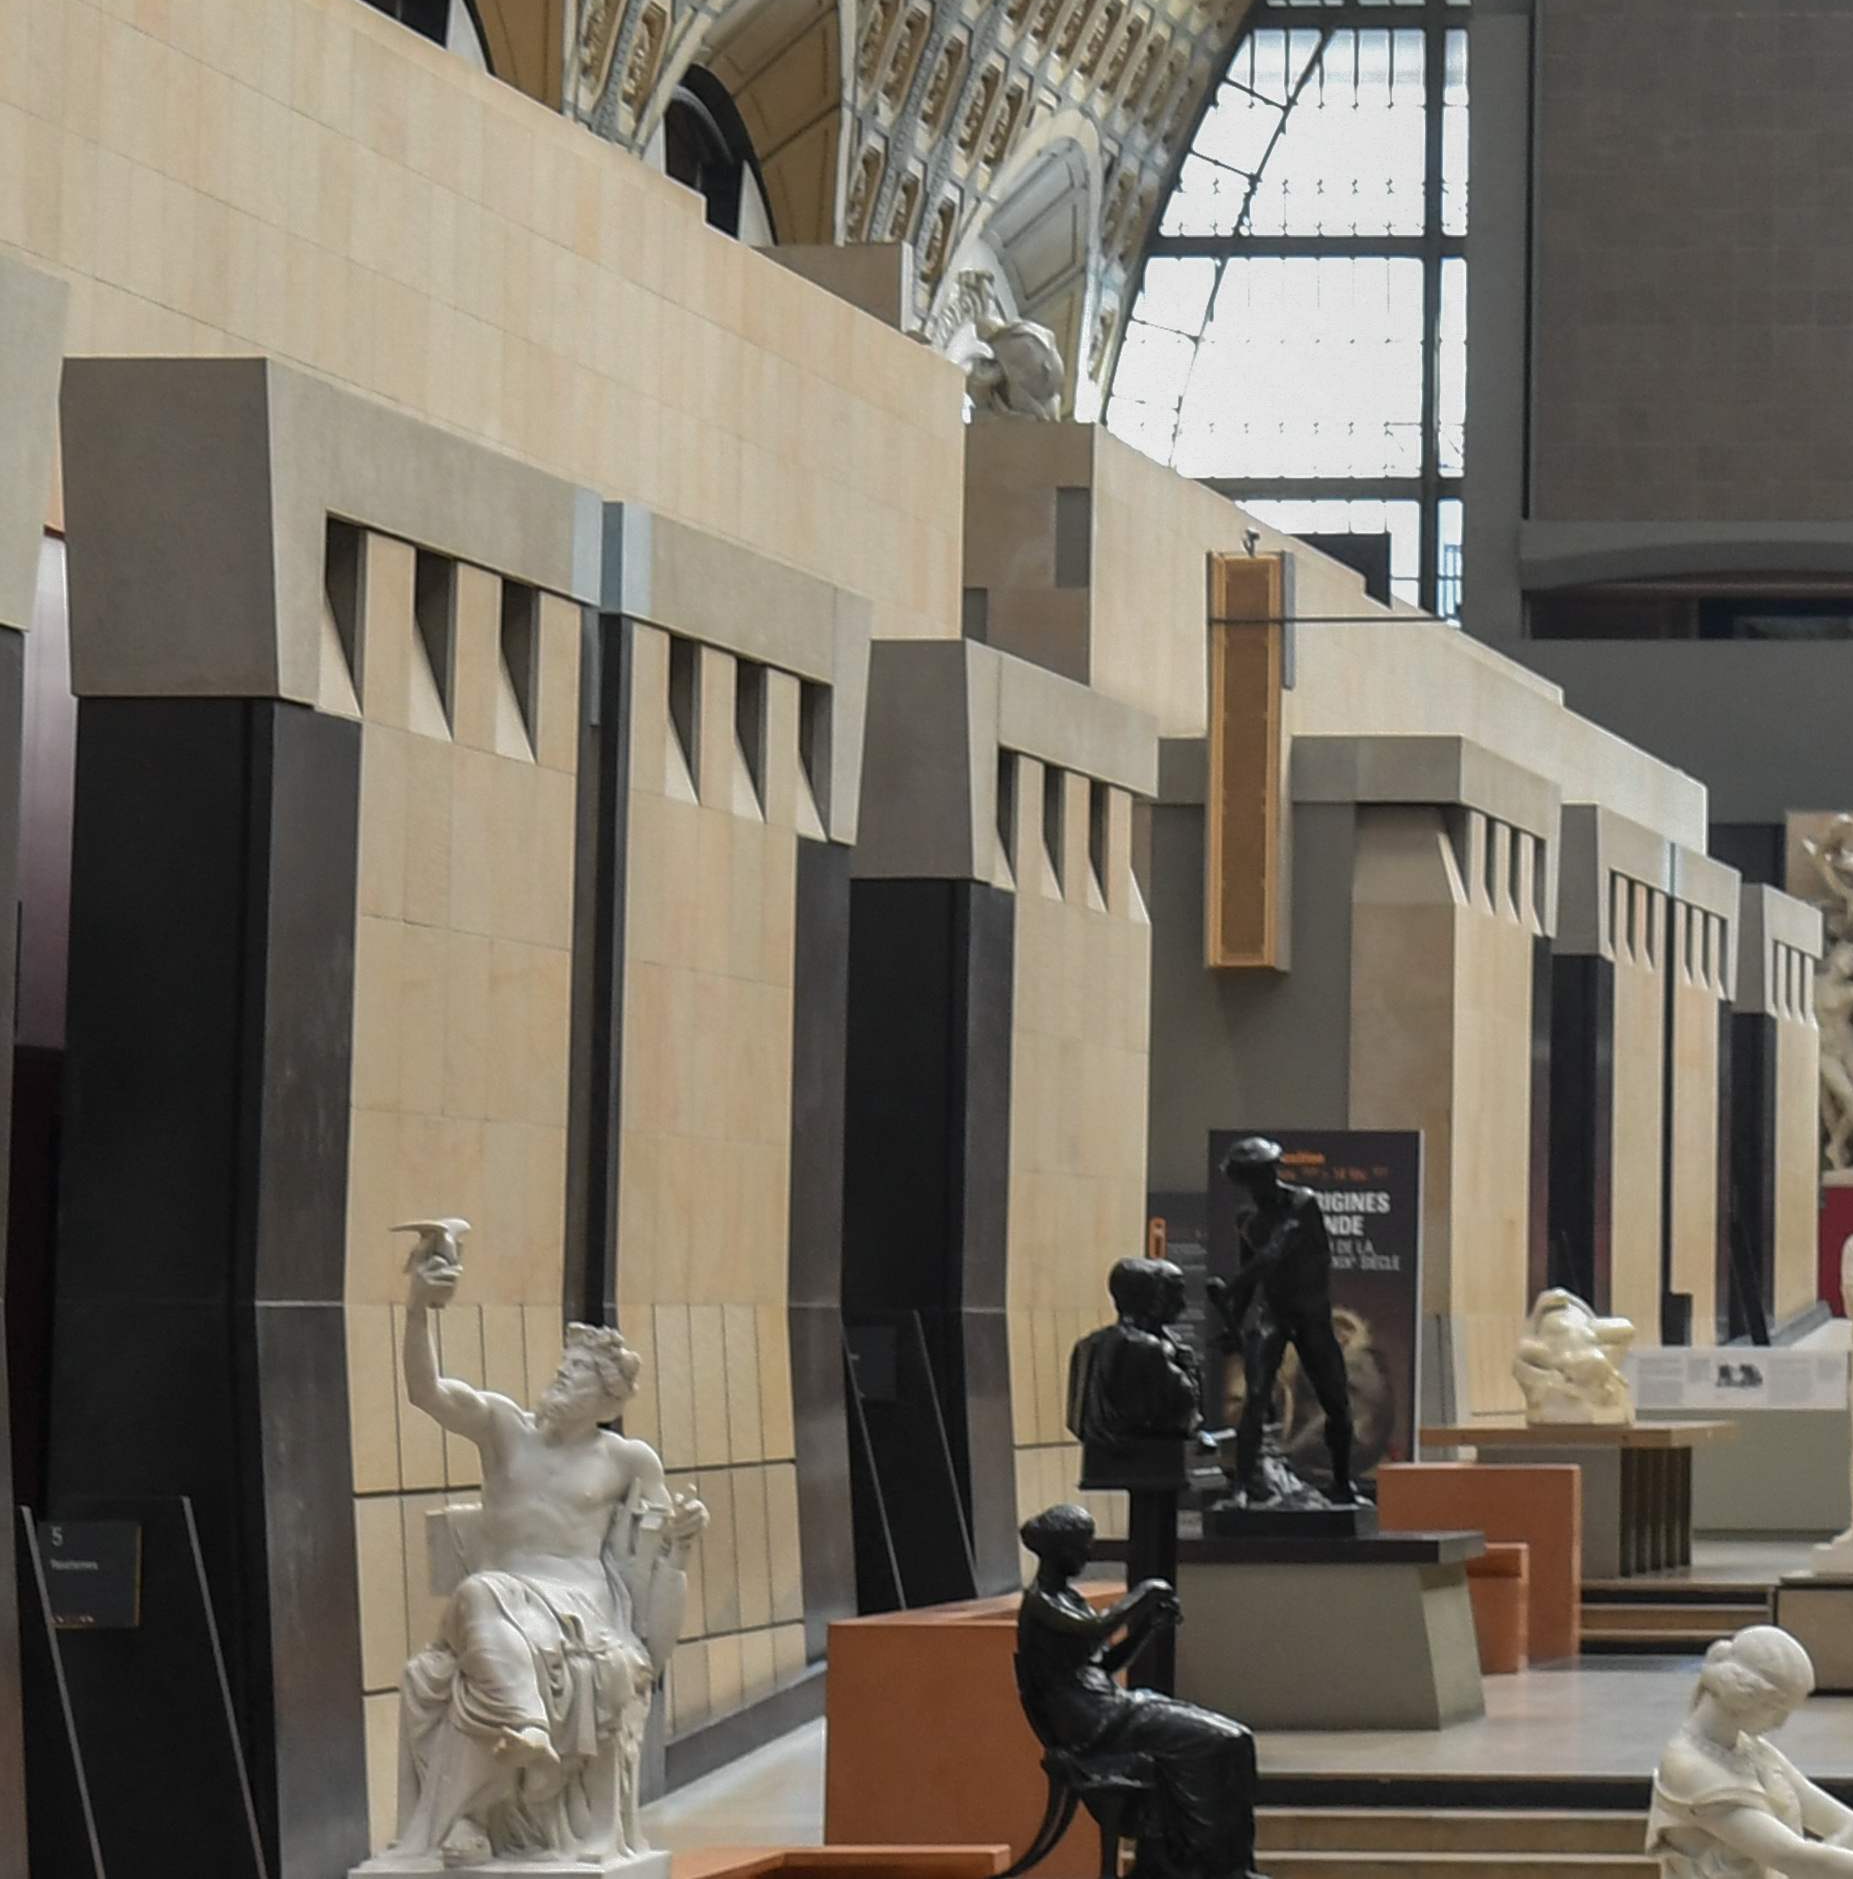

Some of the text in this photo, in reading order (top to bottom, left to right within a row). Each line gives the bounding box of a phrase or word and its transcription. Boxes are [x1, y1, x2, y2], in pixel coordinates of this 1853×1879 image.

[1315, 1191, 1391, 1214] RIGINES
[1323, 1214, 1365, 1236] NDE
[51, 1526, 64, 1547] 5
